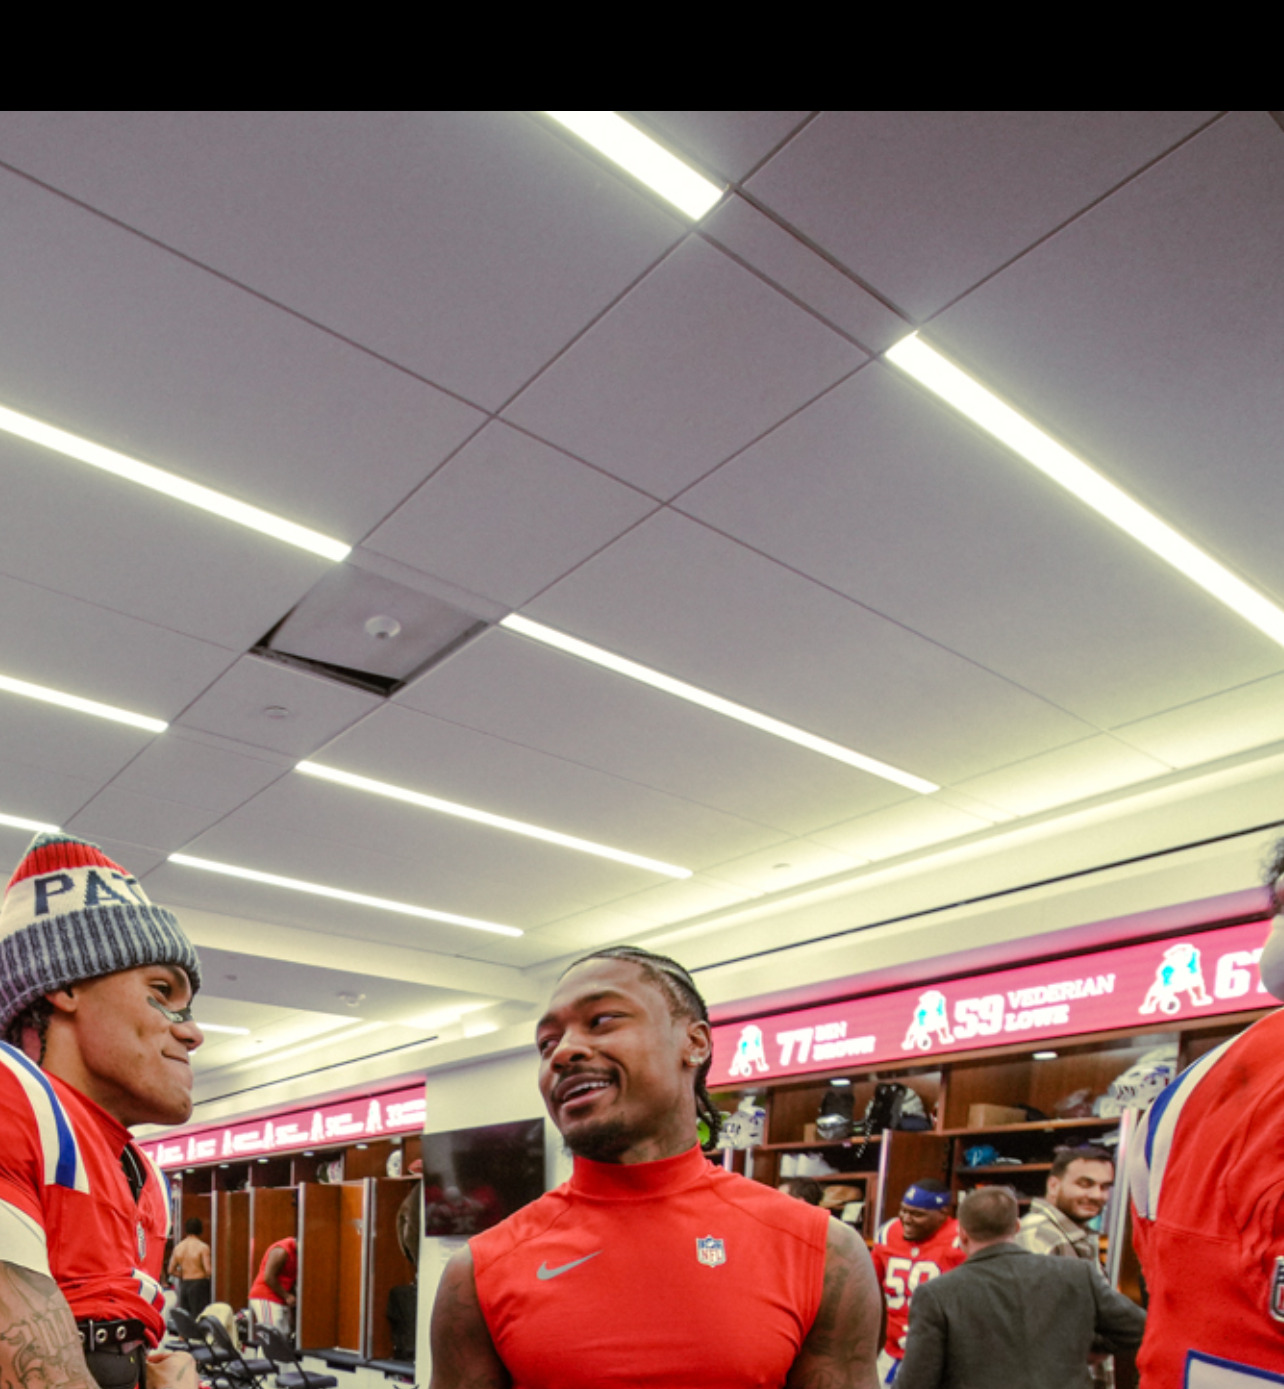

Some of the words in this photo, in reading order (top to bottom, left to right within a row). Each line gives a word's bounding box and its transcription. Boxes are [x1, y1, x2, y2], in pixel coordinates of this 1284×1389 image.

[1006, 974, 1116, 1009] VEDERIAN
[953, 994, 1005, 1039] 59
[1004, 1004, 1070, 1032] LOWE
[776, 1027, 814, 1067] 77
